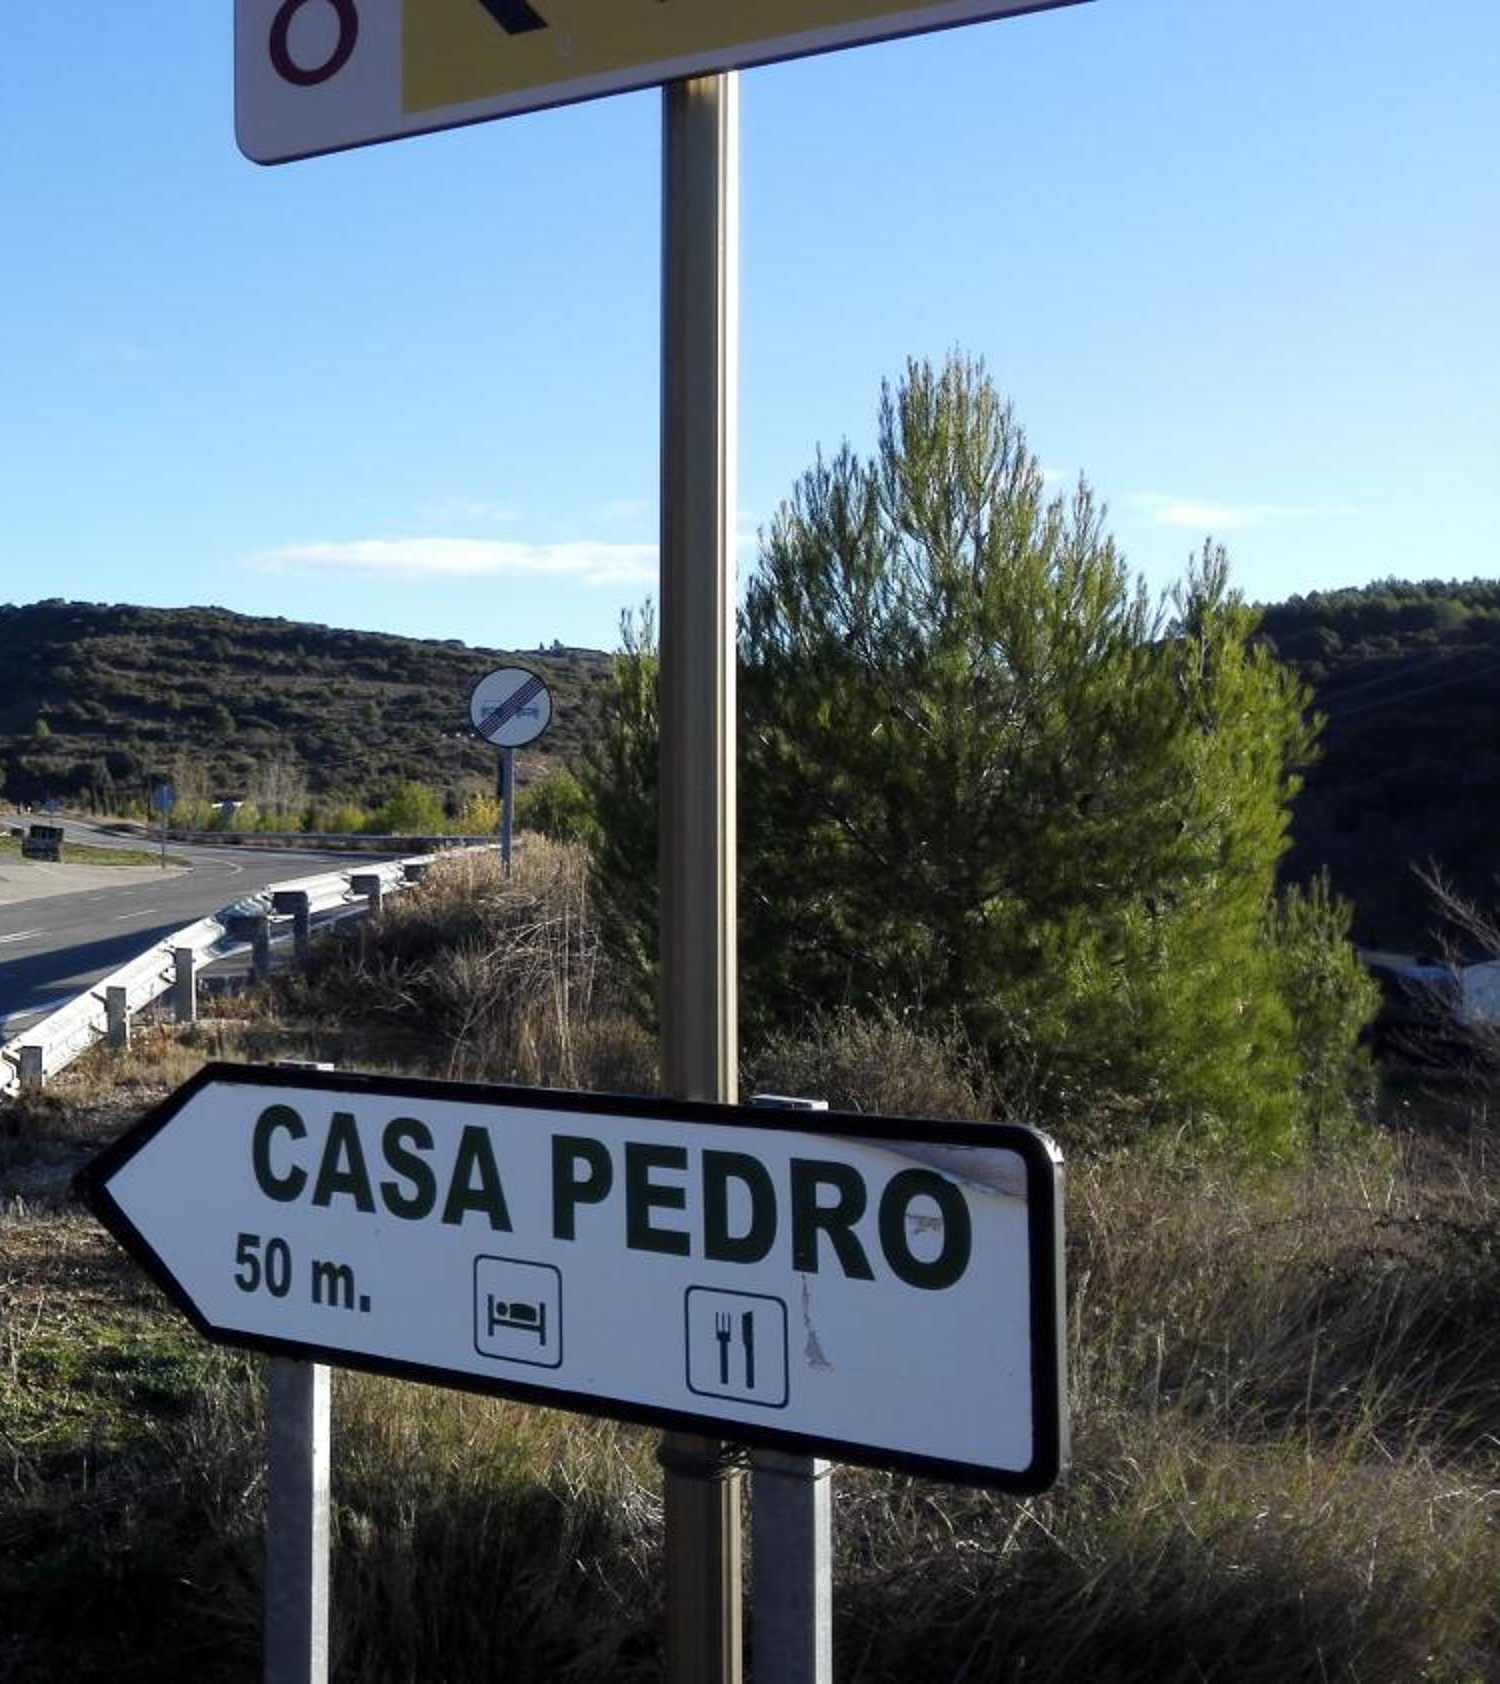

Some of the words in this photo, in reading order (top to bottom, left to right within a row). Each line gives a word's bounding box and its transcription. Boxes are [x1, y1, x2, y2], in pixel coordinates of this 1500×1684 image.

[252, 1103, 514, 1233] CASA
[551, 1133, 974, 1291] PEDRO
[233, 1231, 293, 1299] 50
[311, 1259, 372, 1313] m.
